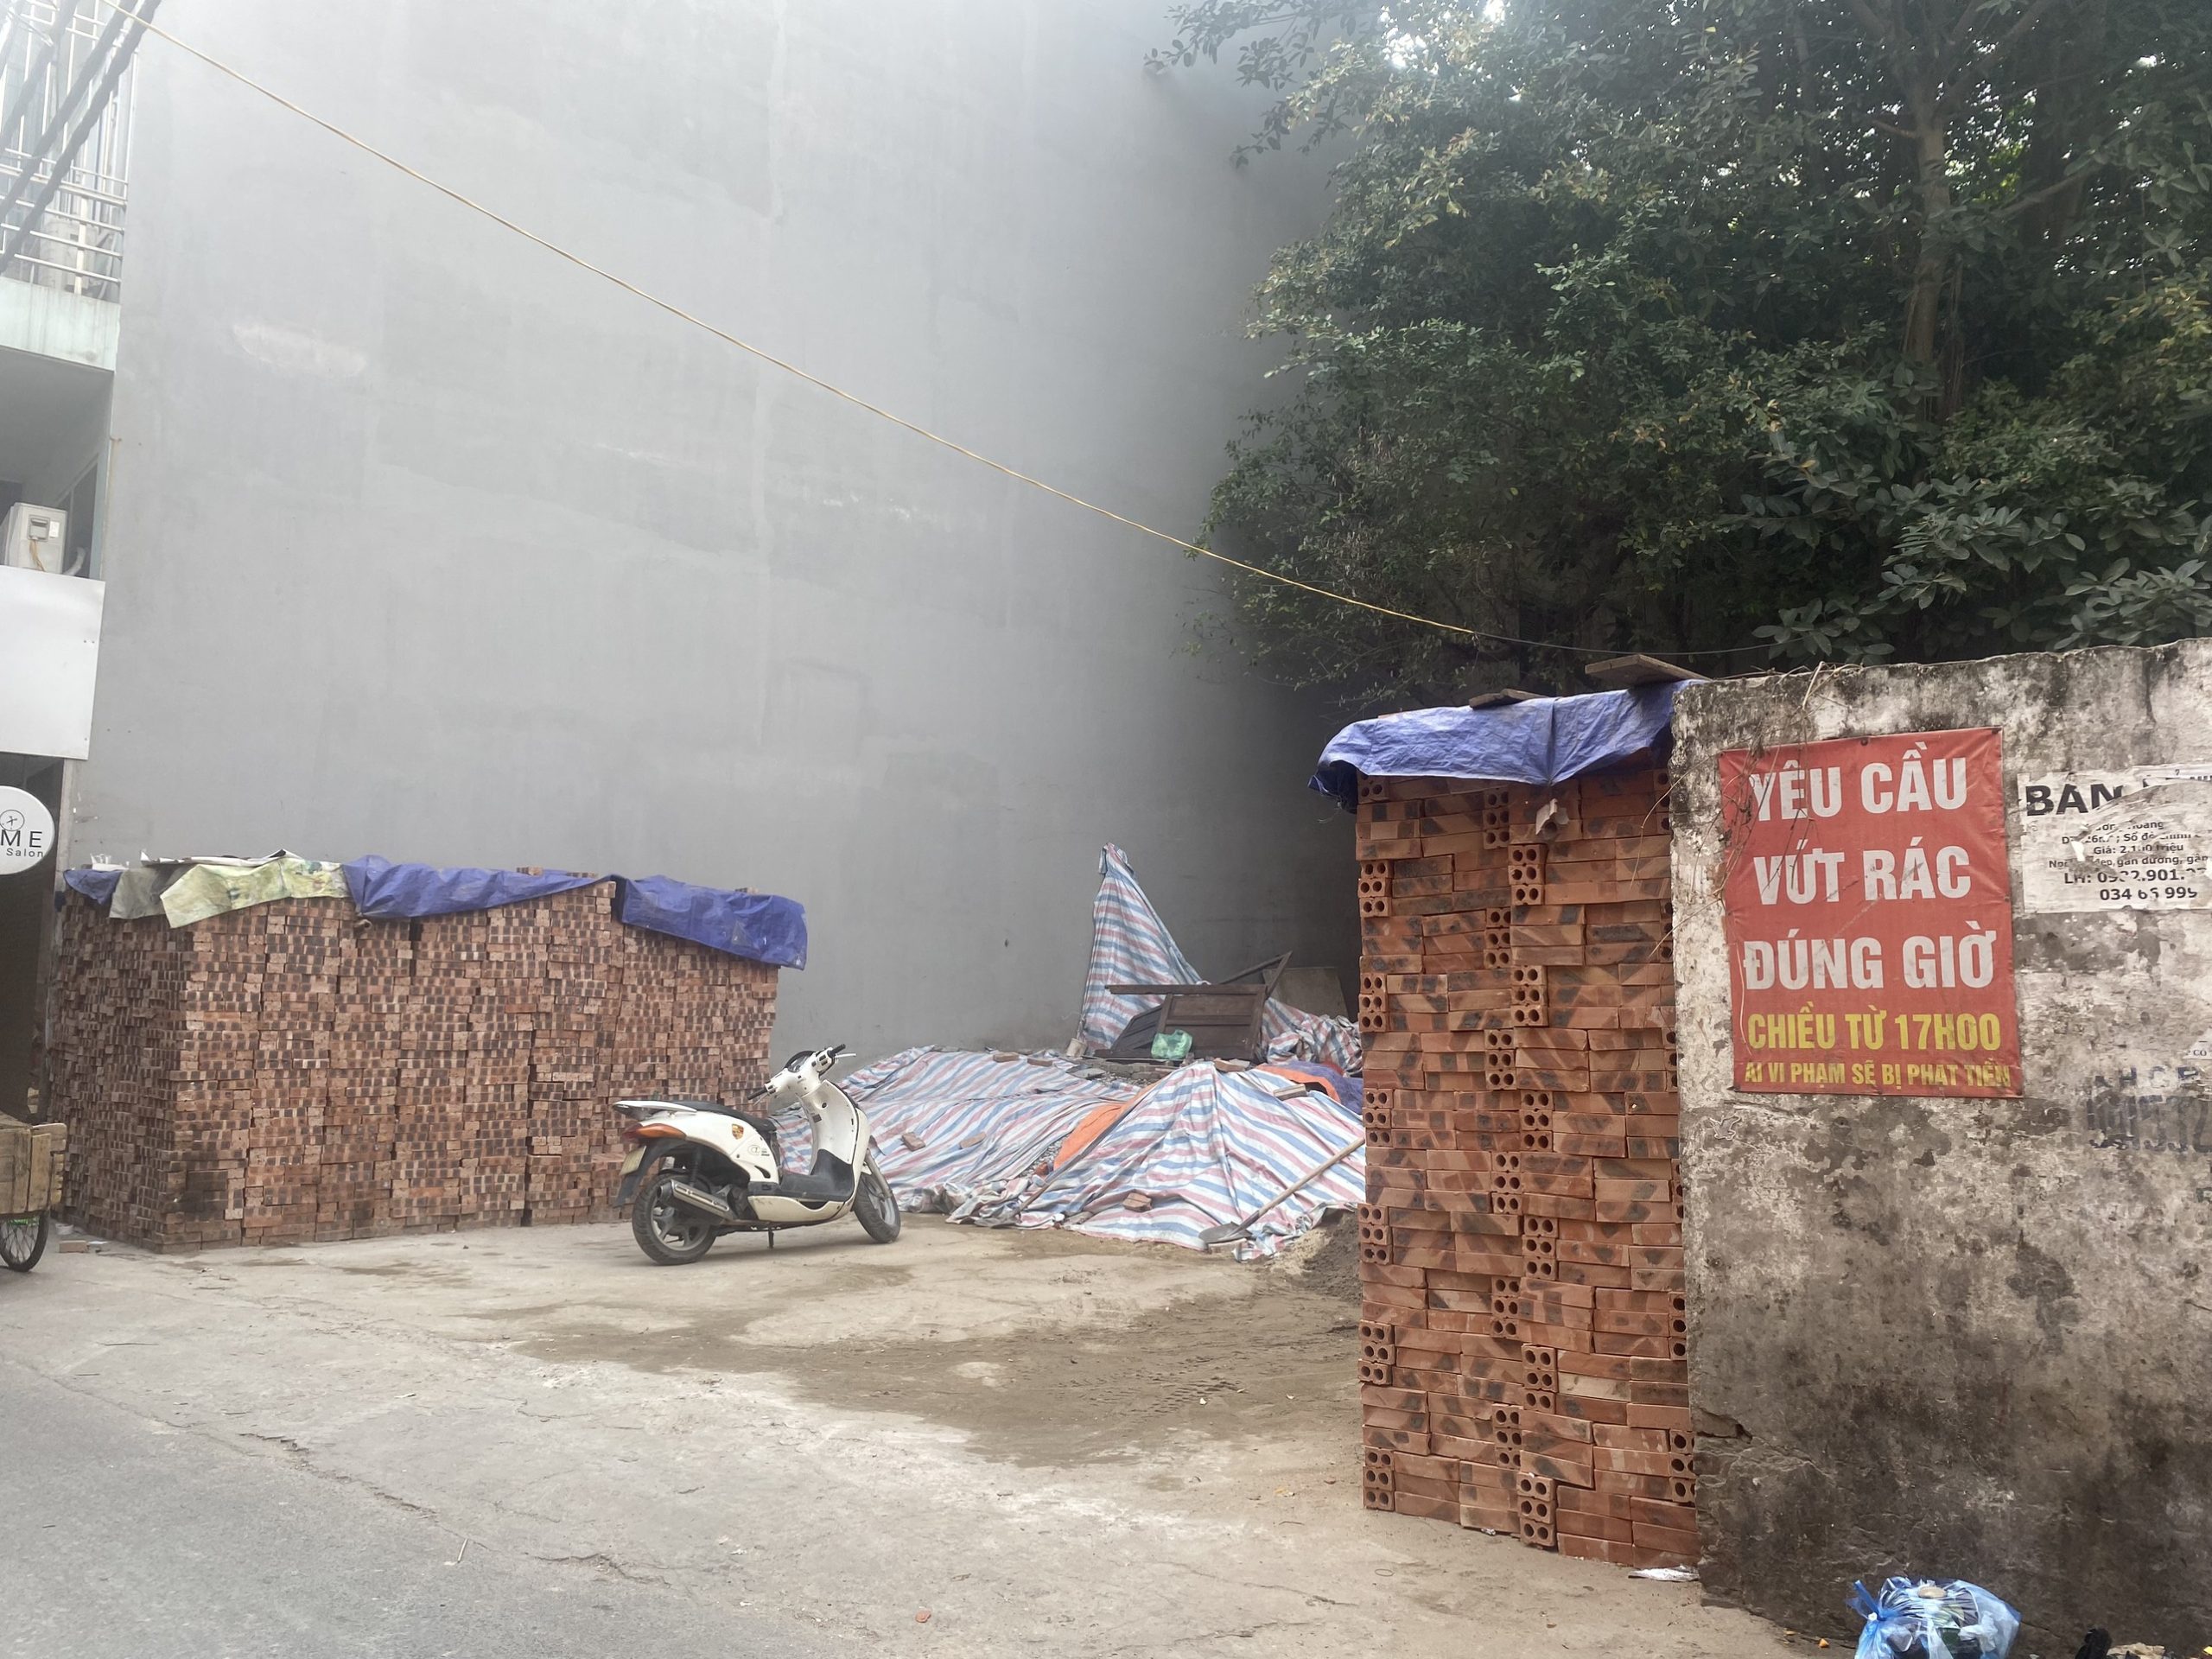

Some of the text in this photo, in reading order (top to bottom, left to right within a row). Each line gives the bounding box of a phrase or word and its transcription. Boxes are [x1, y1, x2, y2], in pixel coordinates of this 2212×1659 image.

[1749, 741, 1967, 821] YÊU CẦU
[6, 848, 43, 857] Salon
[1753, 836, 1971, 905] VỨT RÁC
[2094, 845, 2116, 855] Giá:
[2100, 888, 2132, 900] 034
[1743, 920, 1996, 991] ĐÚNG GIỜ
[1748, 1001, 2001, 1051] CHIỀU TỪ 17H00
[1745, 1062, 1763, 1082] AI
[1768, 1062, 1785, 1083] VI
[1790, 1062, 1846, 1088] PHẠM
[1851, 1059, 1876, 1085] SẼ
[1882, 1063, 1902, 1090] BỊ
[1964, 1058, 2011, 1087] TIỀN
